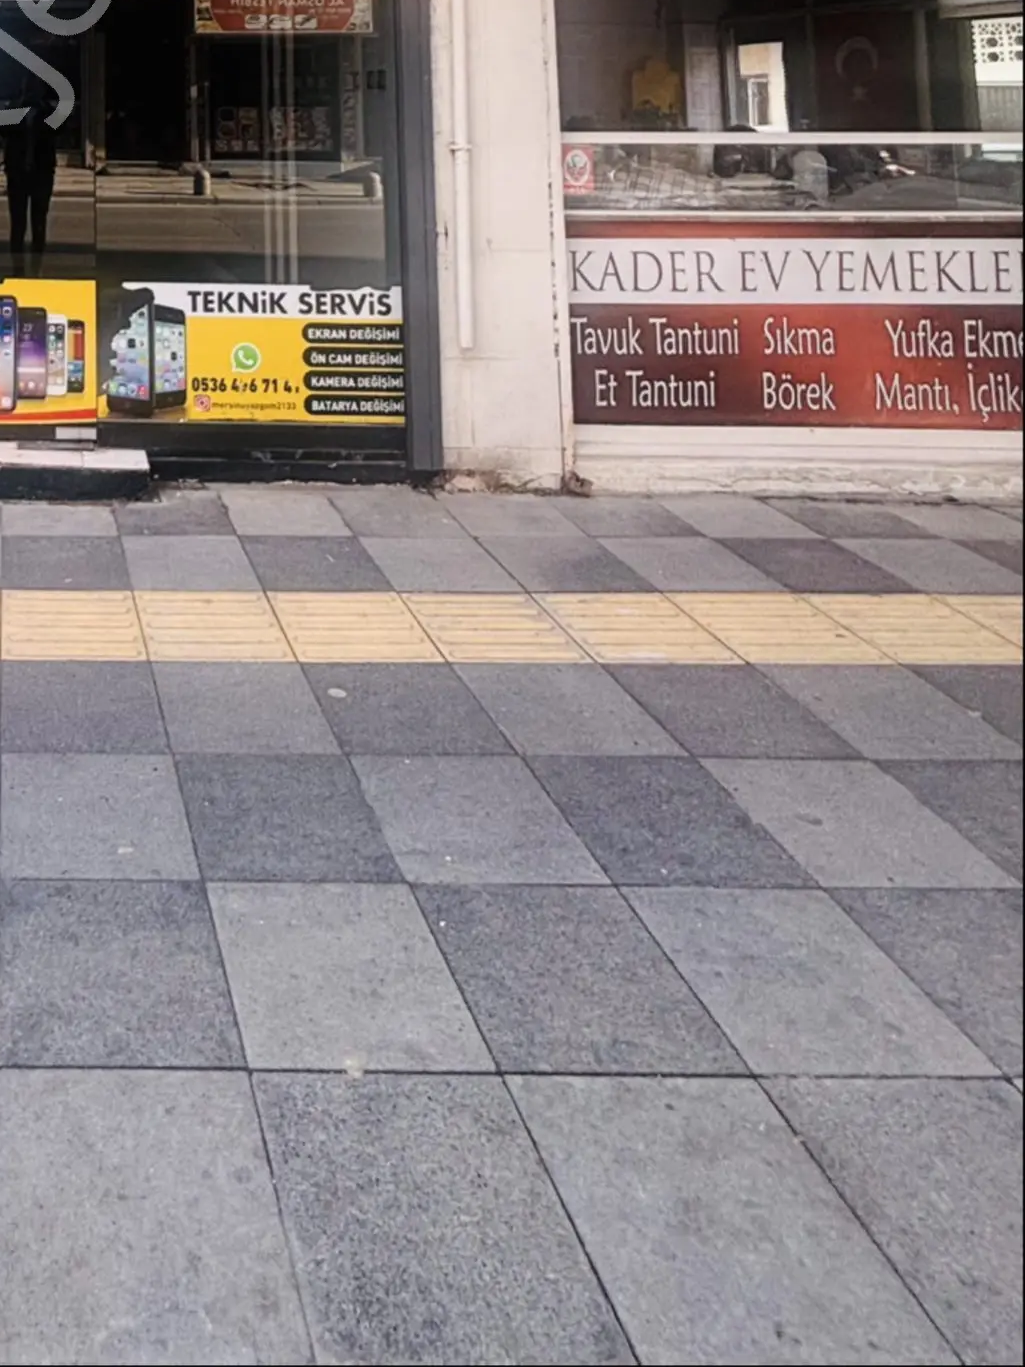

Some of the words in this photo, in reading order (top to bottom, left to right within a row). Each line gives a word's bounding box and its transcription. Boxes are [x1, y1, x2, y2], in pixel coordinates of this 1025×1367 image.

[569, 249, 724, 293] KADER
[740, 250, 792, 293] EV
[803, 249, 1023, 293] YEMEKLE
[308, 328, 347, 340] EKRAN
[570, 316, 644, 356] Tavuk
[649, 317, 740, 356] Tantuni
[884, 317, 954, 358] Yufka
[310, 352, 326, 364] ÖN
[328, 353, 352, 364] CAM
[191, 377, 227, 392] 0536
[262, 378, 278, 393] 71
[311, 376, 355, 387] KAMERA
[594, 370, 617, 408] Et
[625, 370, 716, 408] Tantuni
[762, 370, 836, 411] Börek
[967, 363, 1023, 422] İçlik
[312, 400, 358, 411] BATARYA
